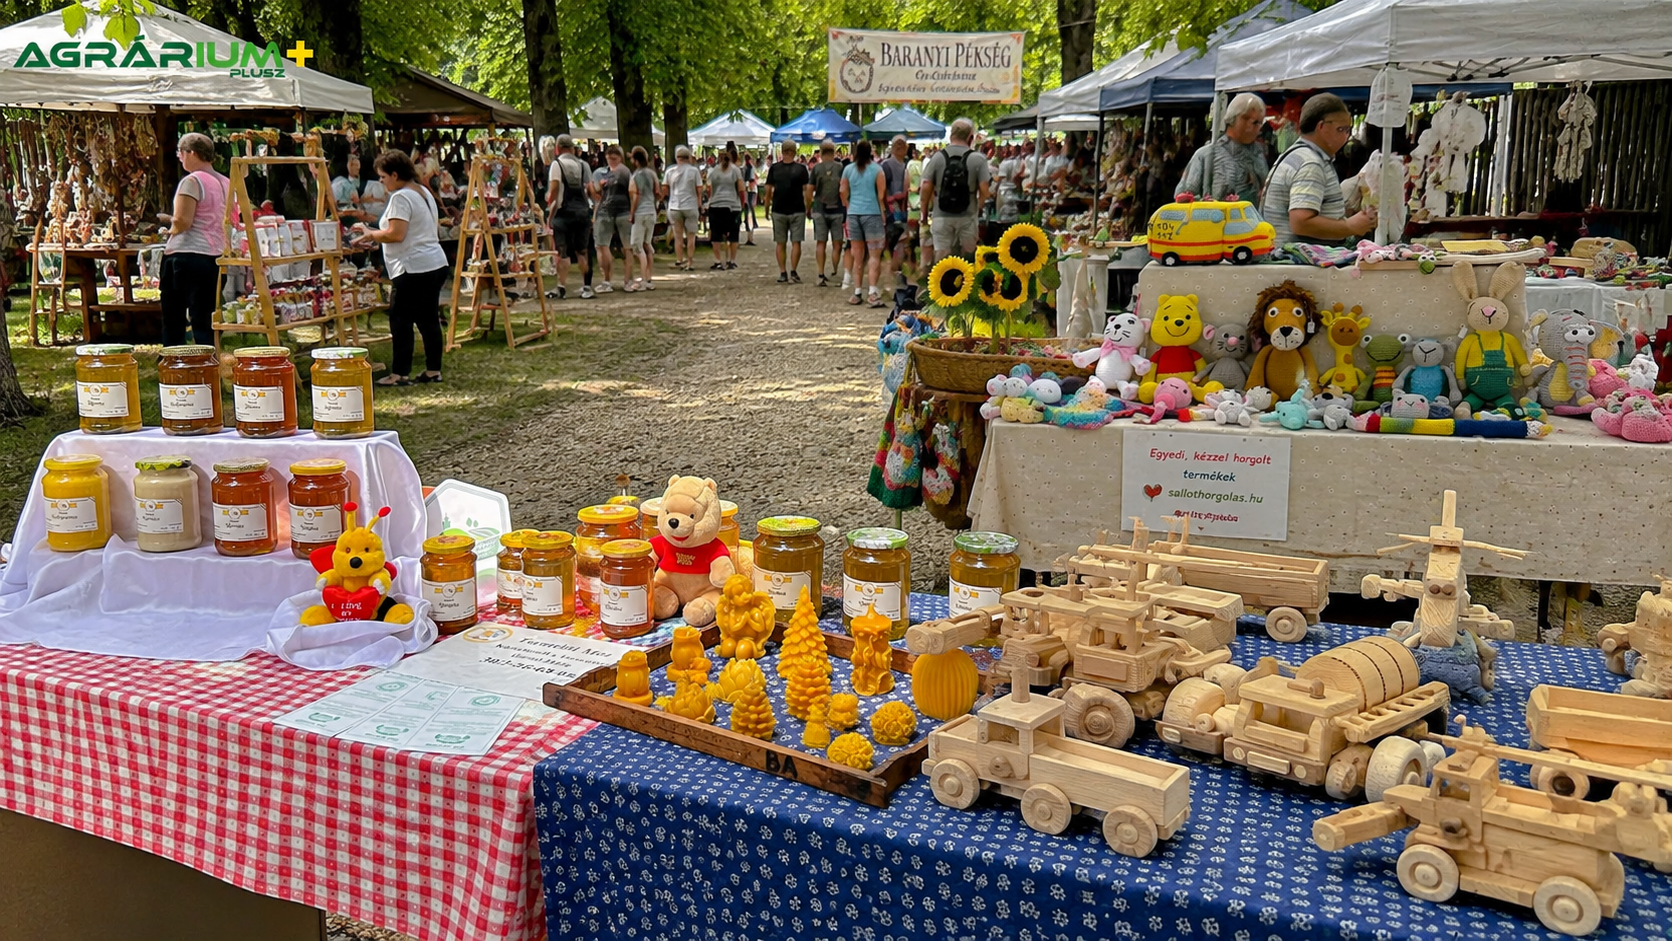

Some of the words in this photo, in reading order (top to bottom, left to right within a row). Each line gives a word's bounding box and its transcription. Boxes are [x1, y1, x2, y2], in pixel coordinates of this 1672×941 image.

[880, 42, 950, 67] BARANYI
[955, 42, 1011, 69] PÉKSÉG
[1150, 448, 1188, 462] Egyedi,
[1193, 451, 1229, 463] kézzel
[1233, 453, 1271, 466] horgolt
[1183, 469, 1236, 482] termékek
[1168, 488, 1263, 503] sallothorgolas.hu
[766, 750, 798, 779] BA
